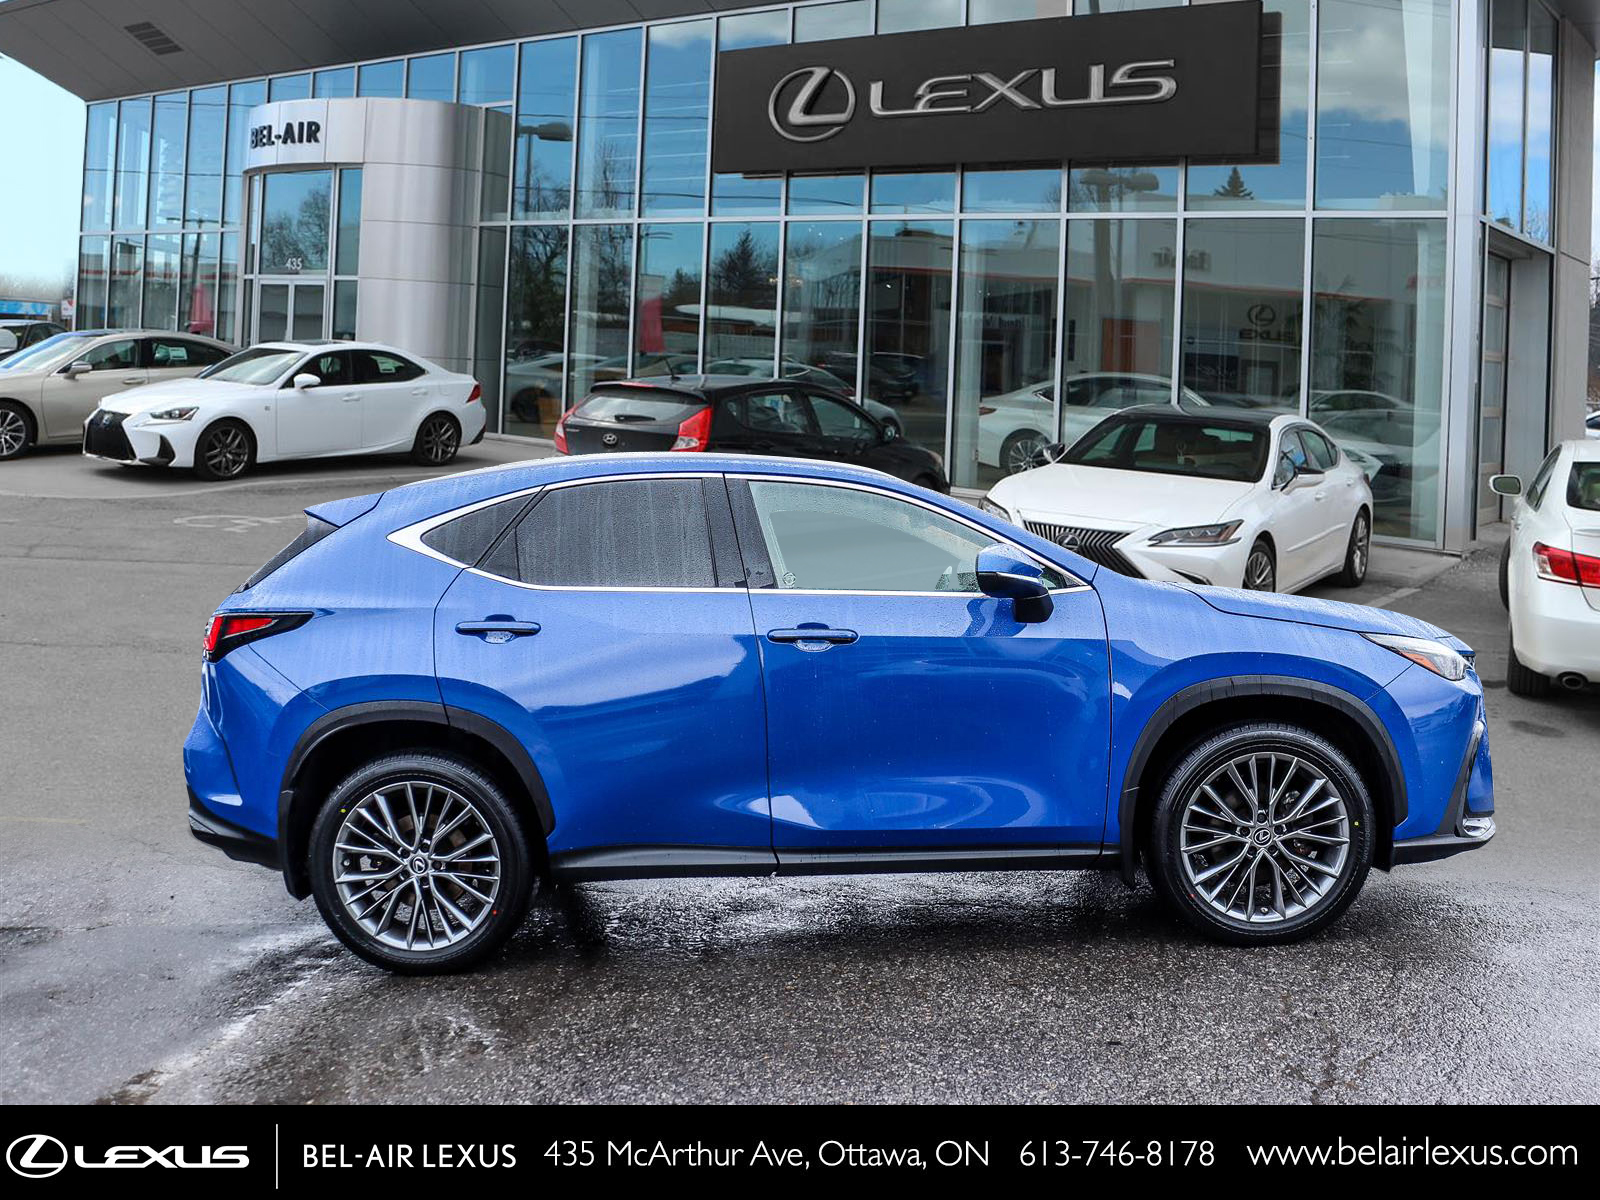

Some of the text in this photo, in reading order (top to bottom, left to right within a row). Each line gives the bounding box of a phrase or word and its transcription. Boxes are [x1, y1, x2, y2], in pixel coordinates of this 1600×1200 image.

[869, 58, 1177, 118] LEXUS
[250, 121, 321, 149] BEL-AIR
[285, 257, 303, 271] 435
